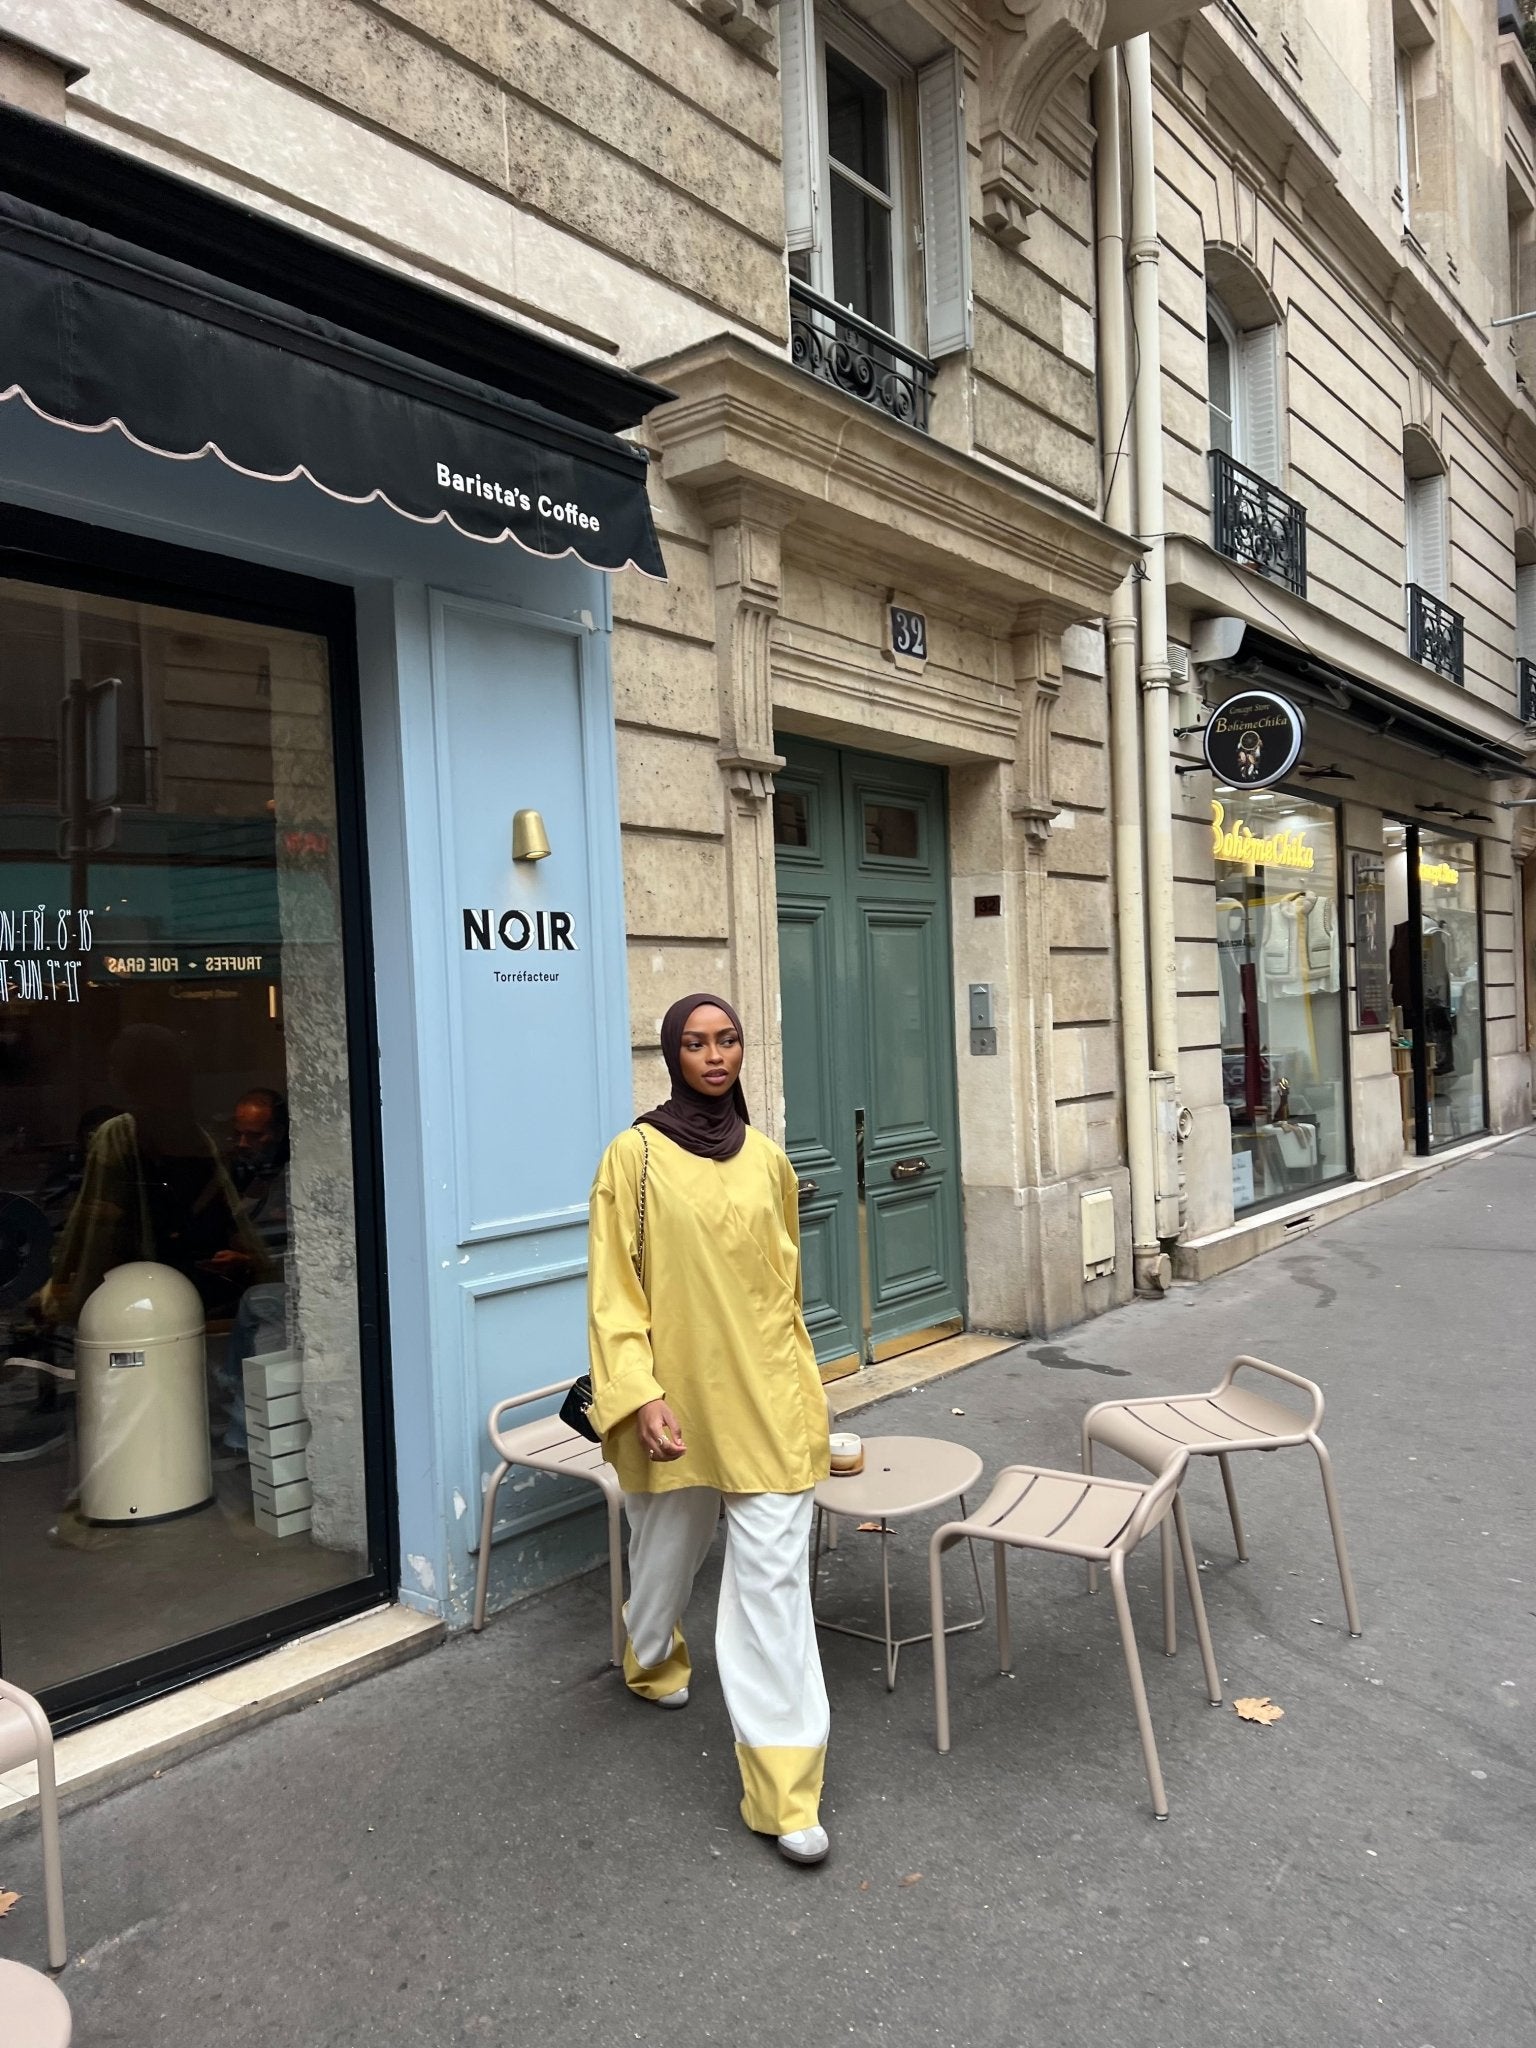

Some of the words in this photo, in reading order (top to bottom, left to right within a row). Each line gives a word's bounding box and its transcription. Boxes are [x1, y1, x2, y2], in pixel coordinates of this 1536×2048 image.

[436, 462, 531, 511] Barista's
[537, 495, 600, 532] Coffee
[896, 612, 924, 655] 32
[979, 900, 996, 912] 32
[462, 908, 580, 951] NOIR
[493, 970, 559, 982] Torréfacteur
